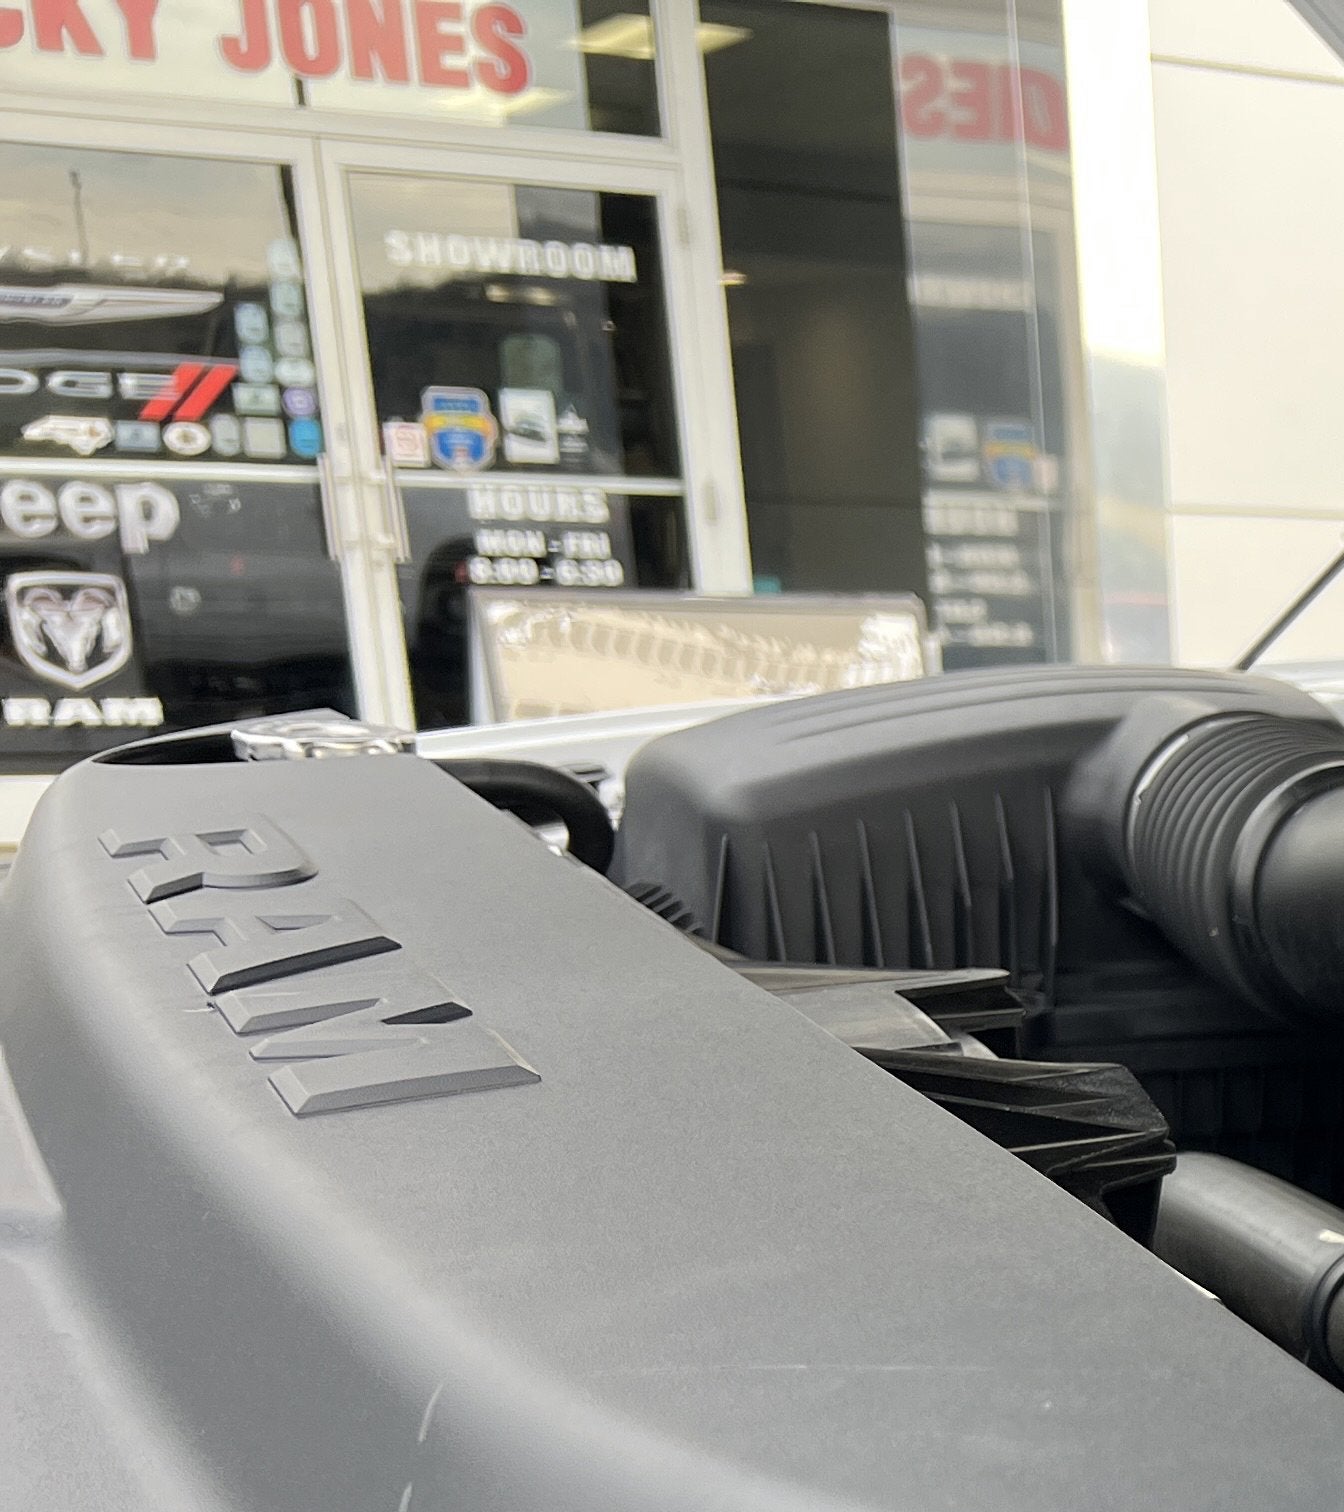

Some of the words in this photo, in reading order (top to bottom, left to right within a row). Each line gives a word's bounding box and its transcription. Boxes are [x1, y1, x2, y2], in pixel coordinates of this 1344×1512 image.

[218, 0, 531, 95] JONES
[385, 229, 638, 283] SHOWROOM
[0, 479, 180, 554] eep
[467, 484, 611, 523] HOURS
[3, 697, 165, 727] RAM
[98, 813, 542, 1118] RAM
